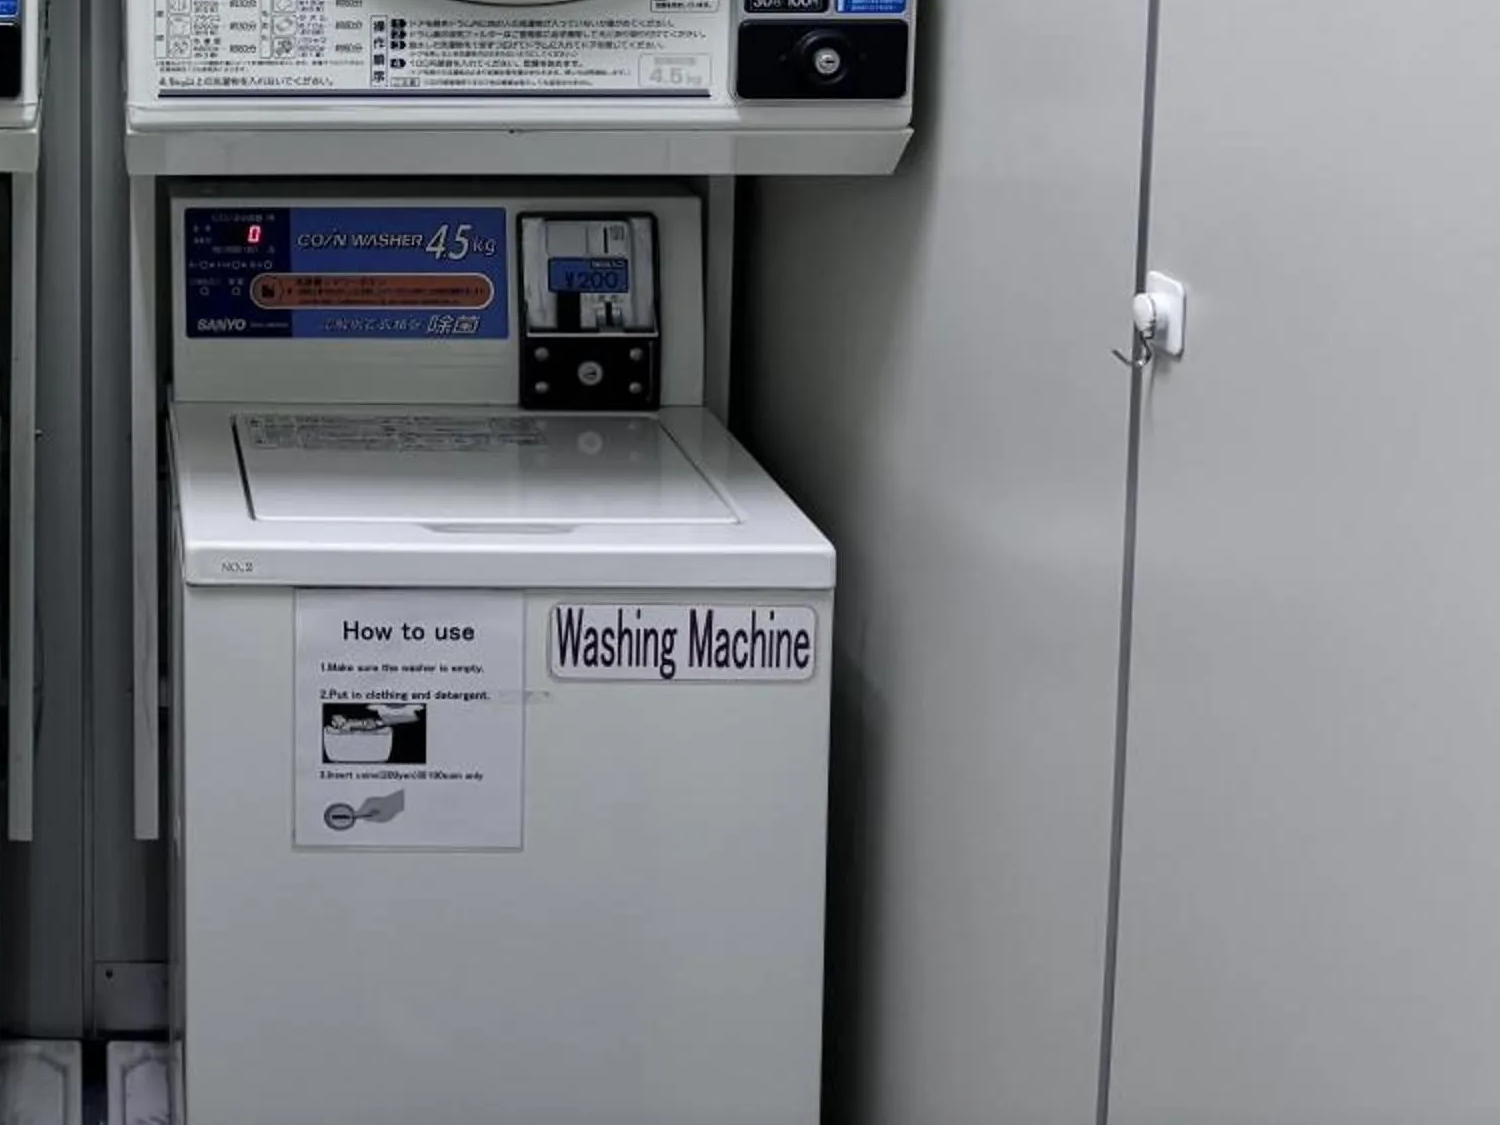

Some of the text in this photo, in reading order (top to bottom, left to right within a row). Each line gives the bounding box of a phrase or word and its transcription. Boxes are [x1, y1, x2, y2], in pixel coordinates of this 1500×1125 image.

[248, 225, 262, 243] 0
[351, 233, 423, 248] WASHER
[196, 317, 247, 332] SANYO
[342, 620, 476, 642] How to use
[556, 606, 810, 680] Washing Machine
[319, 689, 348, 700] 2.Put
[411, 690, 431, 700] and
